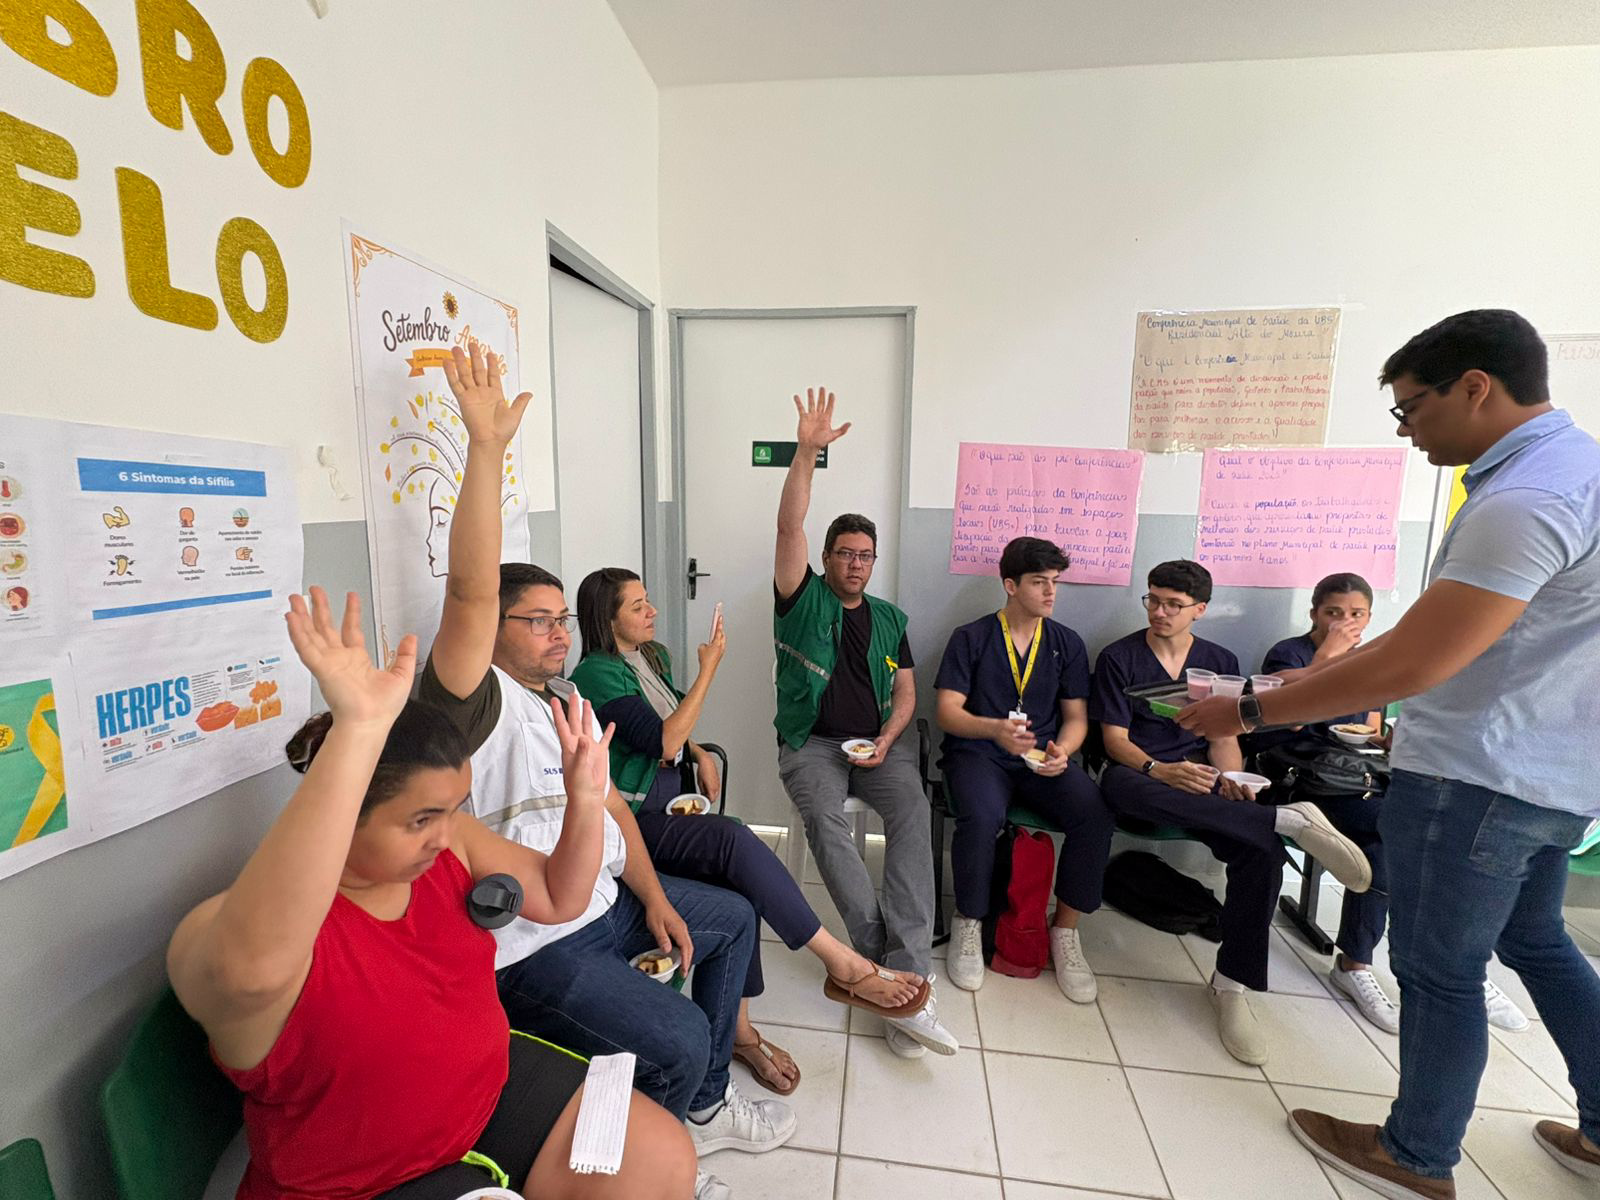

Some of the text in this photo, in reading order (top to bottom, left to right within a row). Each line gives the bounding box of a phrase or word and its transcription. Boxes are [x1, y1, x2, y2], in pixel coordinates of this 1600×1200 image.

[1247, 316, 1257, 326] de
[1298, 317, 1309, 326] da
[1314, 315, 1334, 325] UBS
[382, 307, 450, 352] Setembro
[118, 471, 236, 488] 6 Sintomas da Sífilis
[1053, 487, 1065, 498] da
[96, 675, 192, 740] HERPES
[543, 767, 559, 776] SUS
